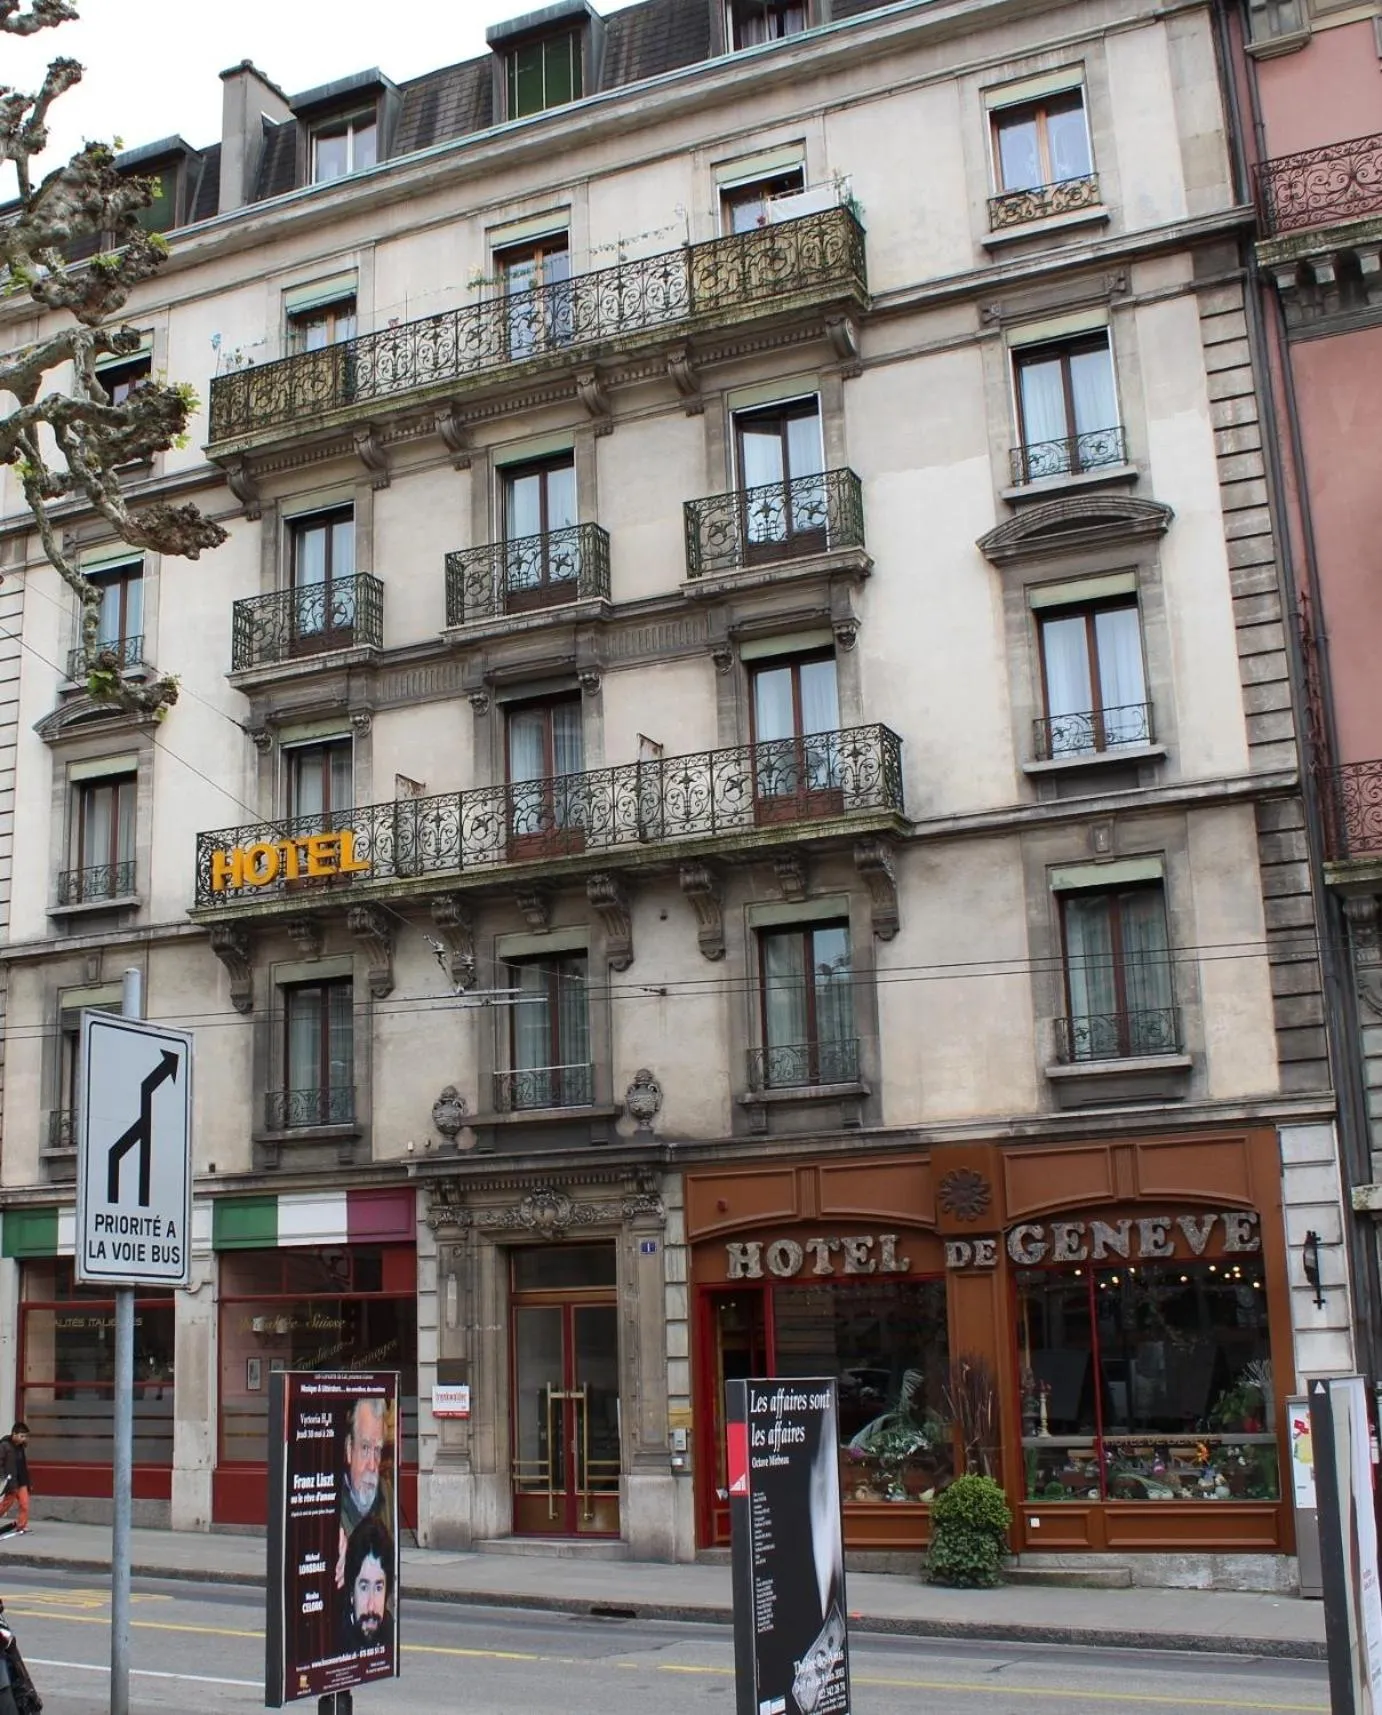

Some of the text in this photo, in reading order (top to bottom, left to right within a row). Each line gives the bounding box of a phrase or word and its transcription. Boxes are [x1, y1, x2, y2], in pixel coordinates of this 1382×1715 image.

[212, 829, 371, 891] HOTEL
[95, 1214, 176, 1238] PRIORITÉ A
[89, 1240, 180, 1264] LA VOIE BUS
[726, 1212, 1261, 1279] HOTEL DE GENEVE
[750, 1388, 831, 1419] Les affaires sont
[751, 1420, 805, 1453] les affaires
[294, 1472, 334, 1490] Franz Liszt
